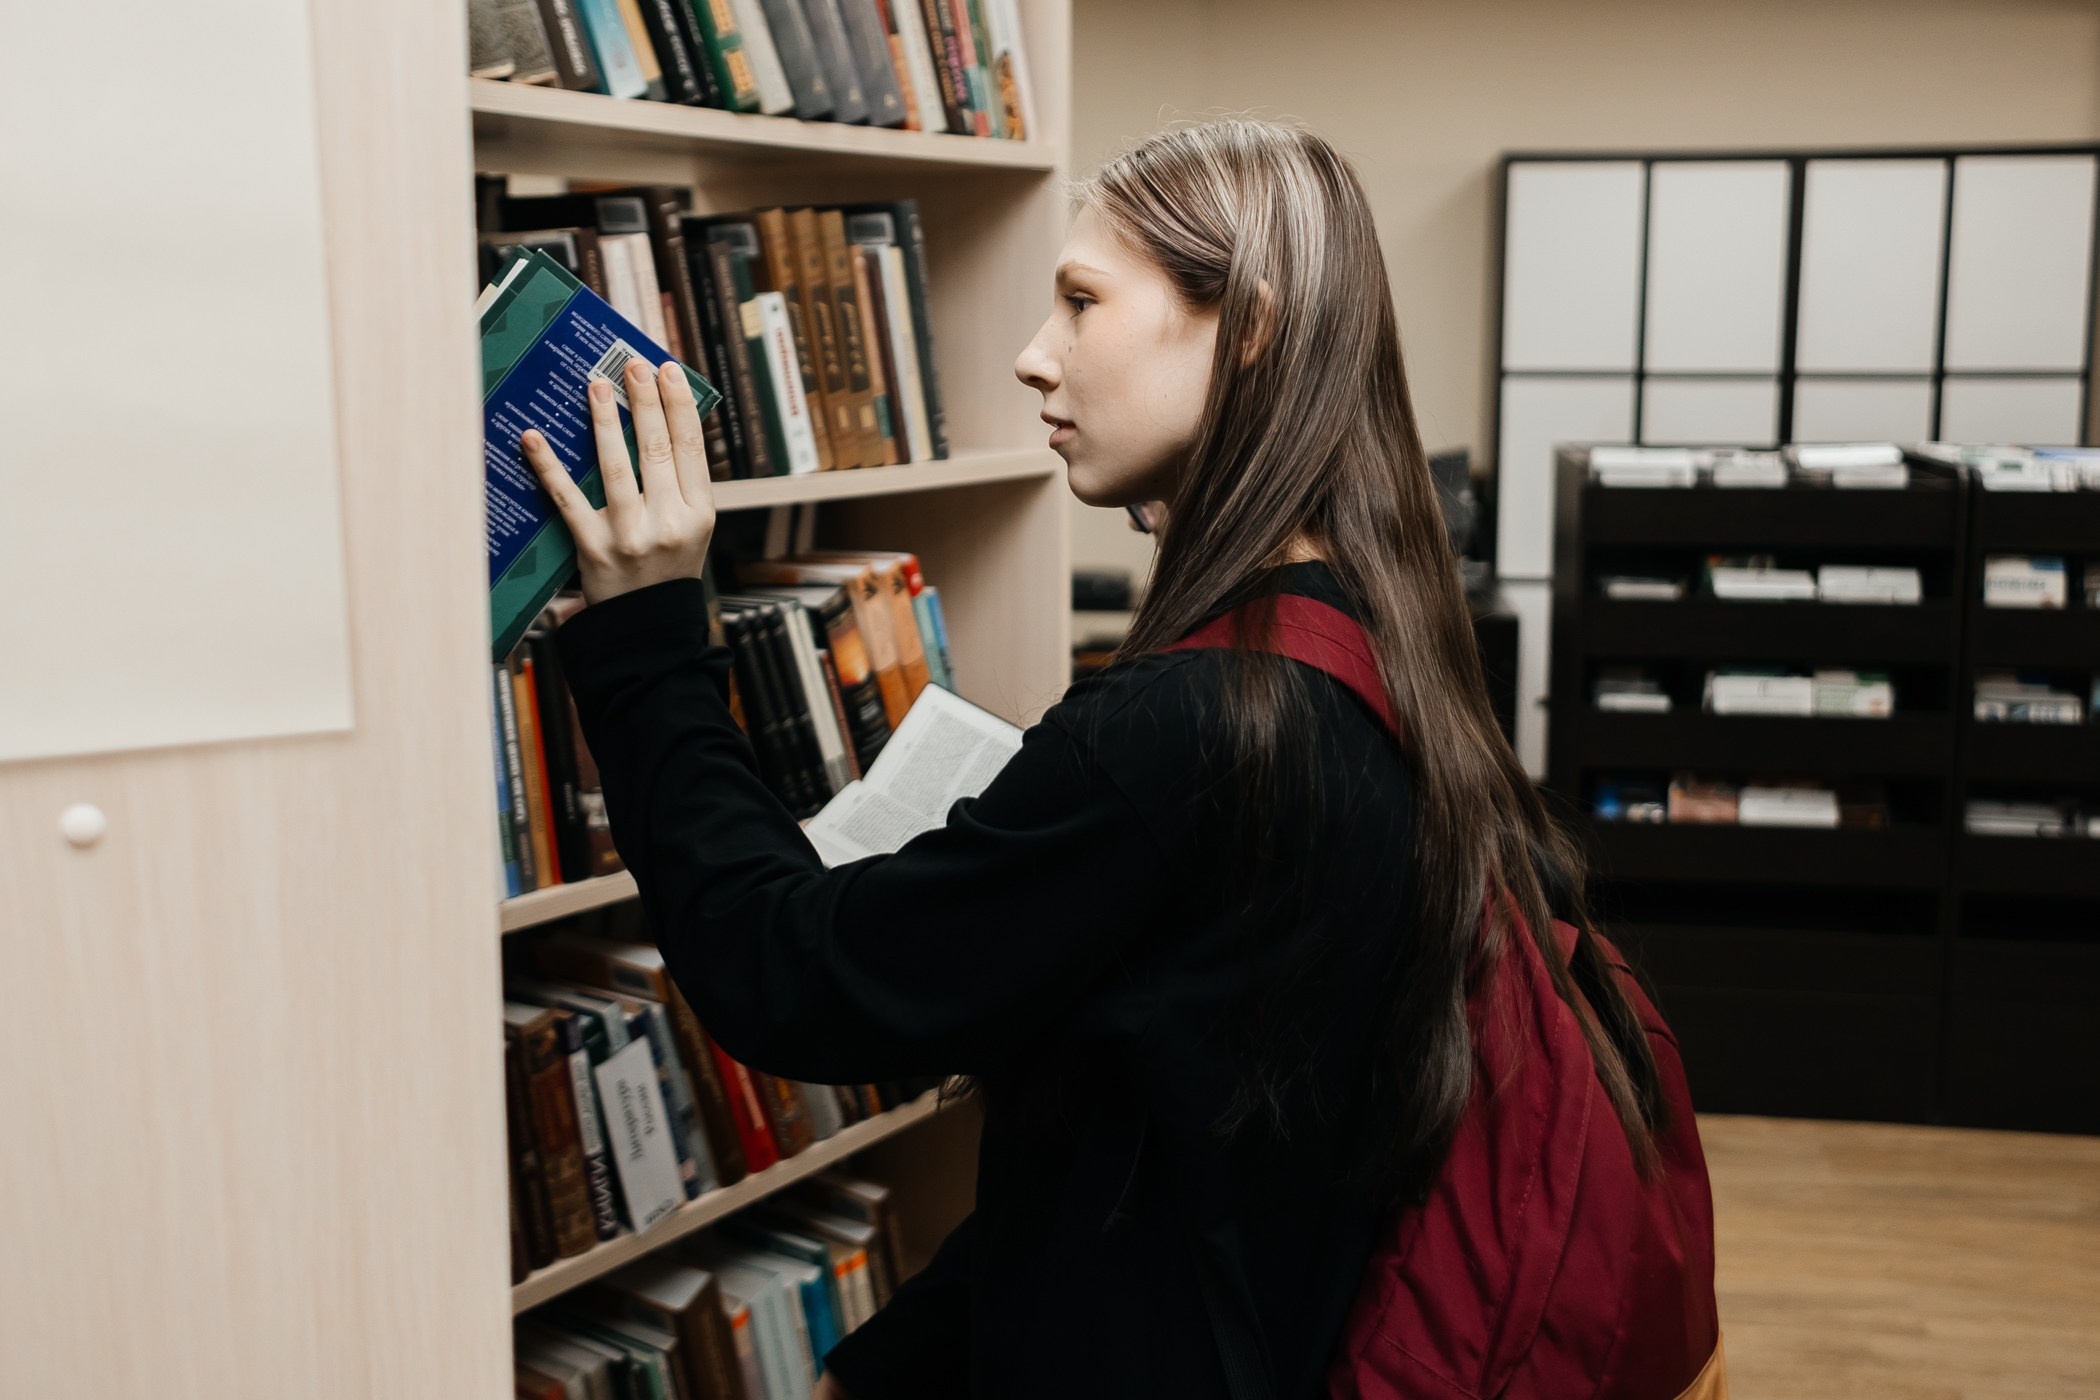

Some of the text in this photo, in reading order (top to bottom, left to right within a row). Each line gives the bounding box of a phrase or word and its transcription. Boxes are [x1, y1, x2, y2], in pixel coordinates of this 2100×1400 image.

[561, 344, 575, 355] сленг
[599, 334, 613, 345] сленг
[504, 401, 535, 425] музыкальный
[537, 426, 565, 448] спортивный
[564, 447, 581, 461] жаргон
[529, 401, 575, 438] компьютерный сленг
